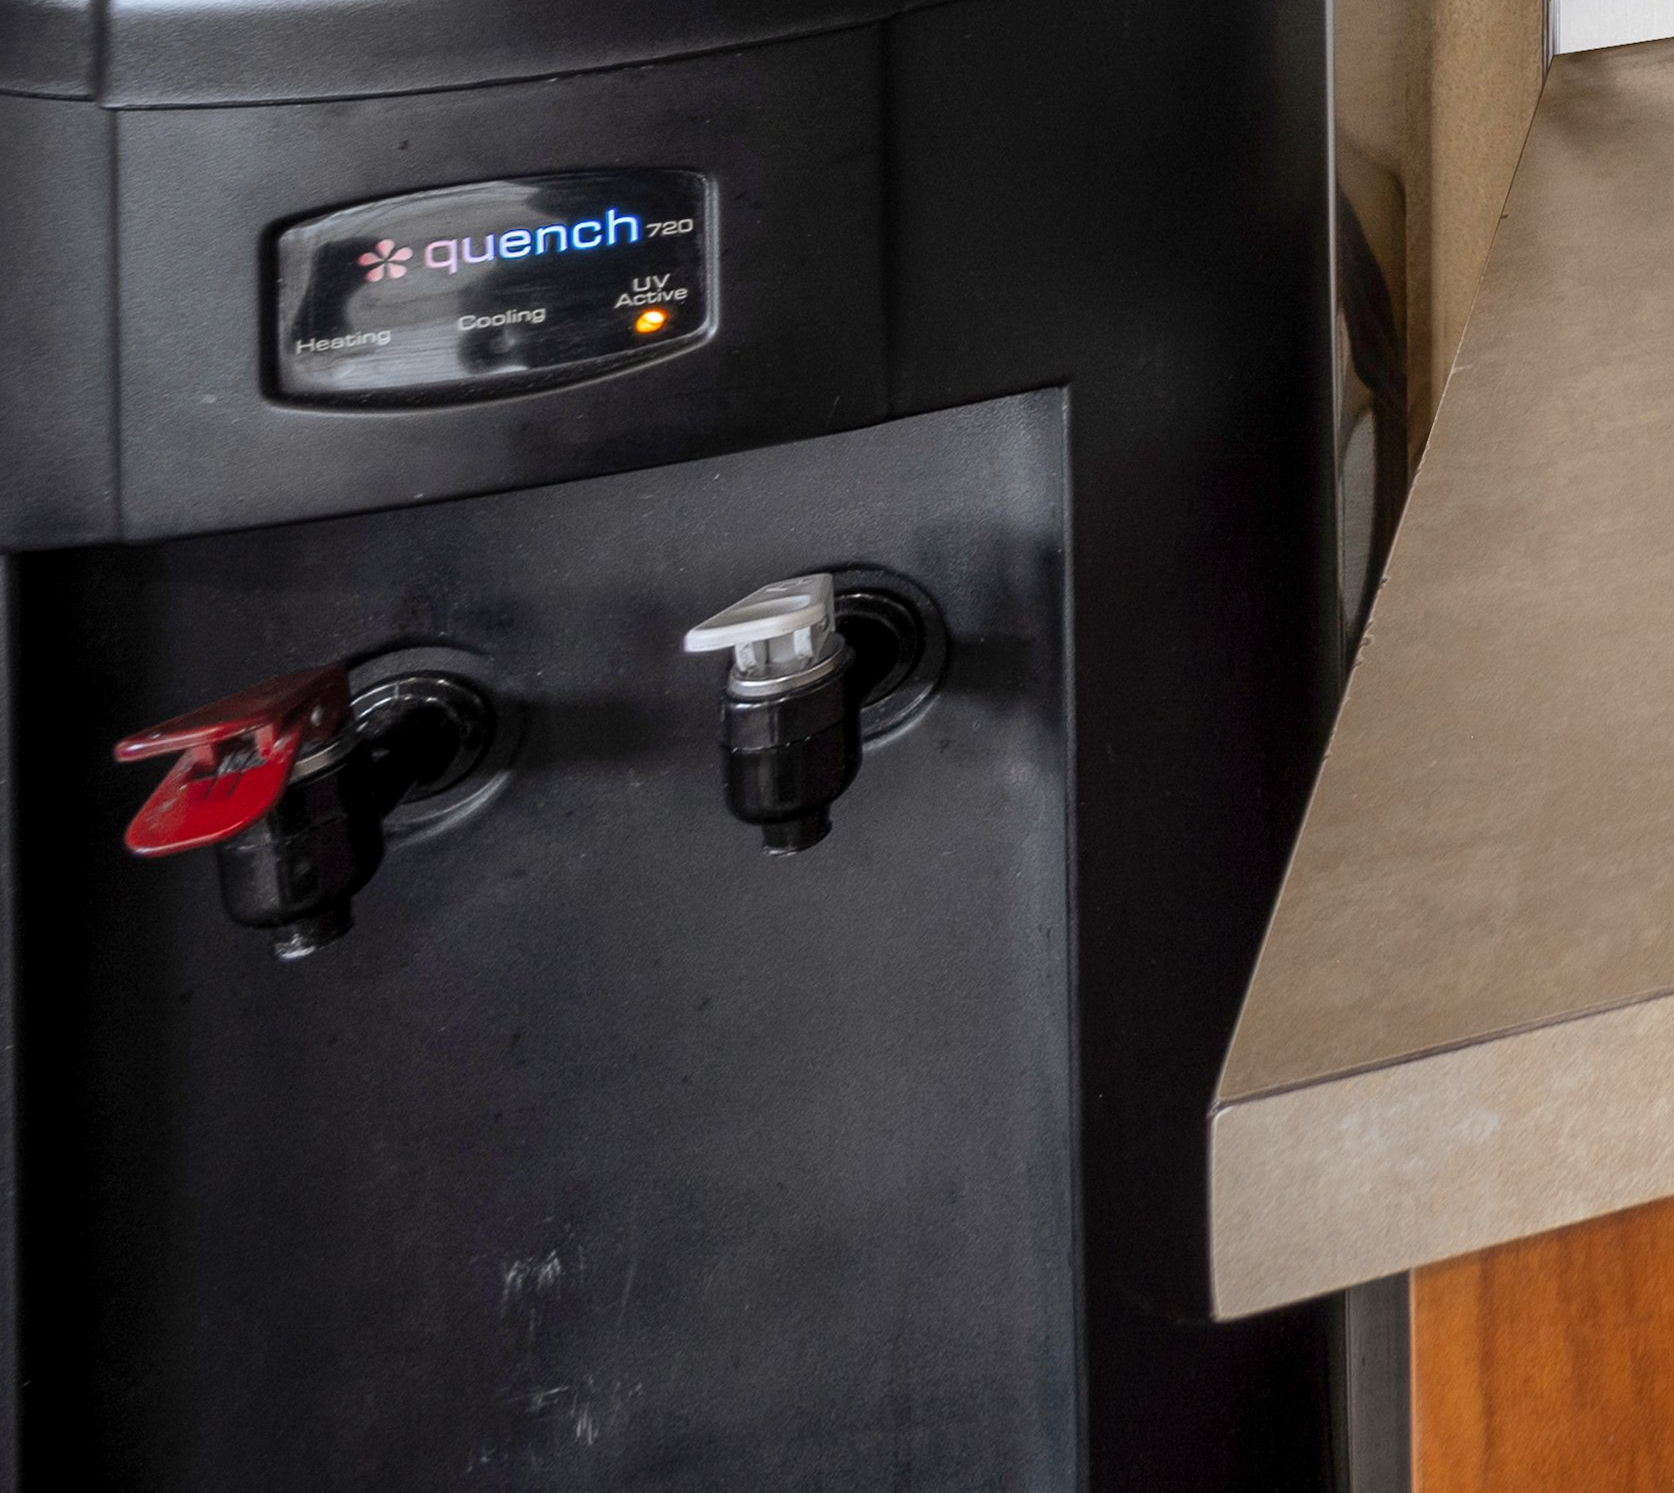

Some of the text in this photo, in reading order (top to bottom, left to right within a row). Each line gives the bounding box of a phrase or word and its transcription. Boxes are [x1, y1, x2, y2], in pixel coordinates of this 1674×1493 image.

[423, 207, 694, 275] quench 720
[631, 273, 670, 292] UV
[614, 285, 689, 310] Active
[457, 307, 547, 333] Cooling
[295, 328, 392, 355] Heating
